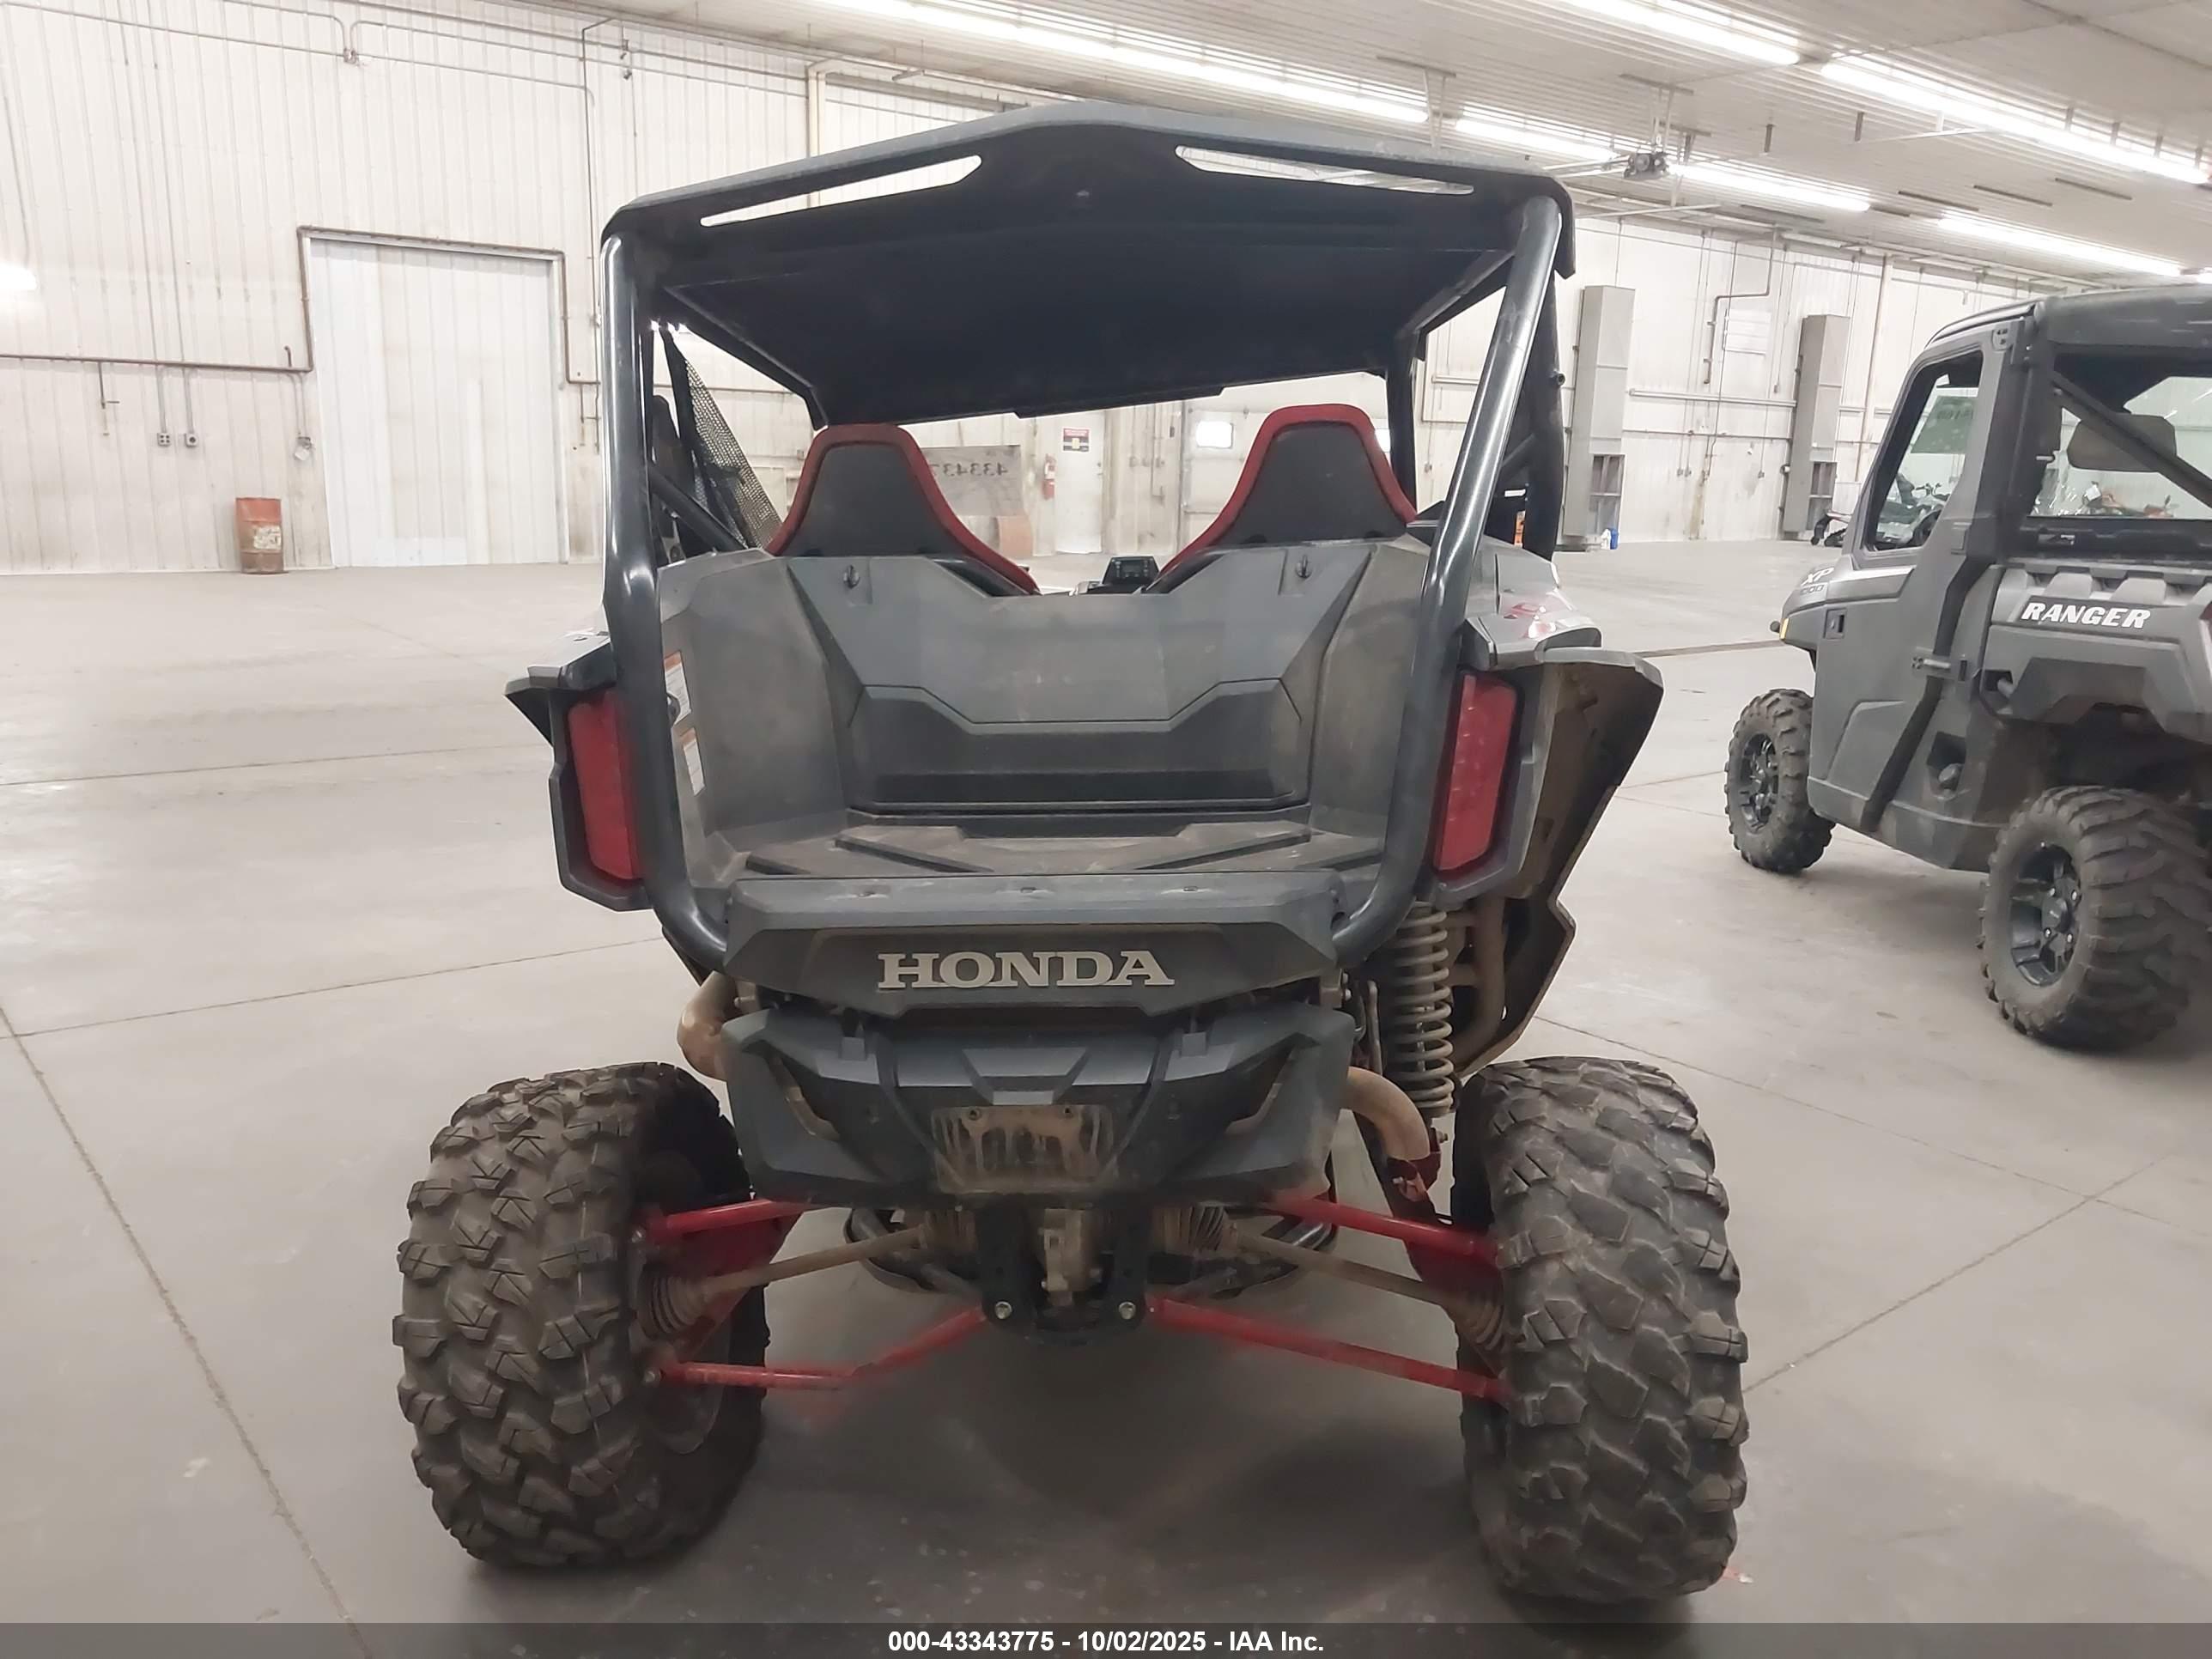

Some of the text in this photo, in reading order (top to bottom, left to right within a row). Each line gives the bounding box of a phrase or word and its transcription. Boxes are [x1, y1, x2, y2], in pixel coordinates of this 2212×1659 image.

[1801, 567, 1835, 586] XP
[2021, 602, 2151, 629] RANGER
[878, 951, 1176, 988] HONDA
